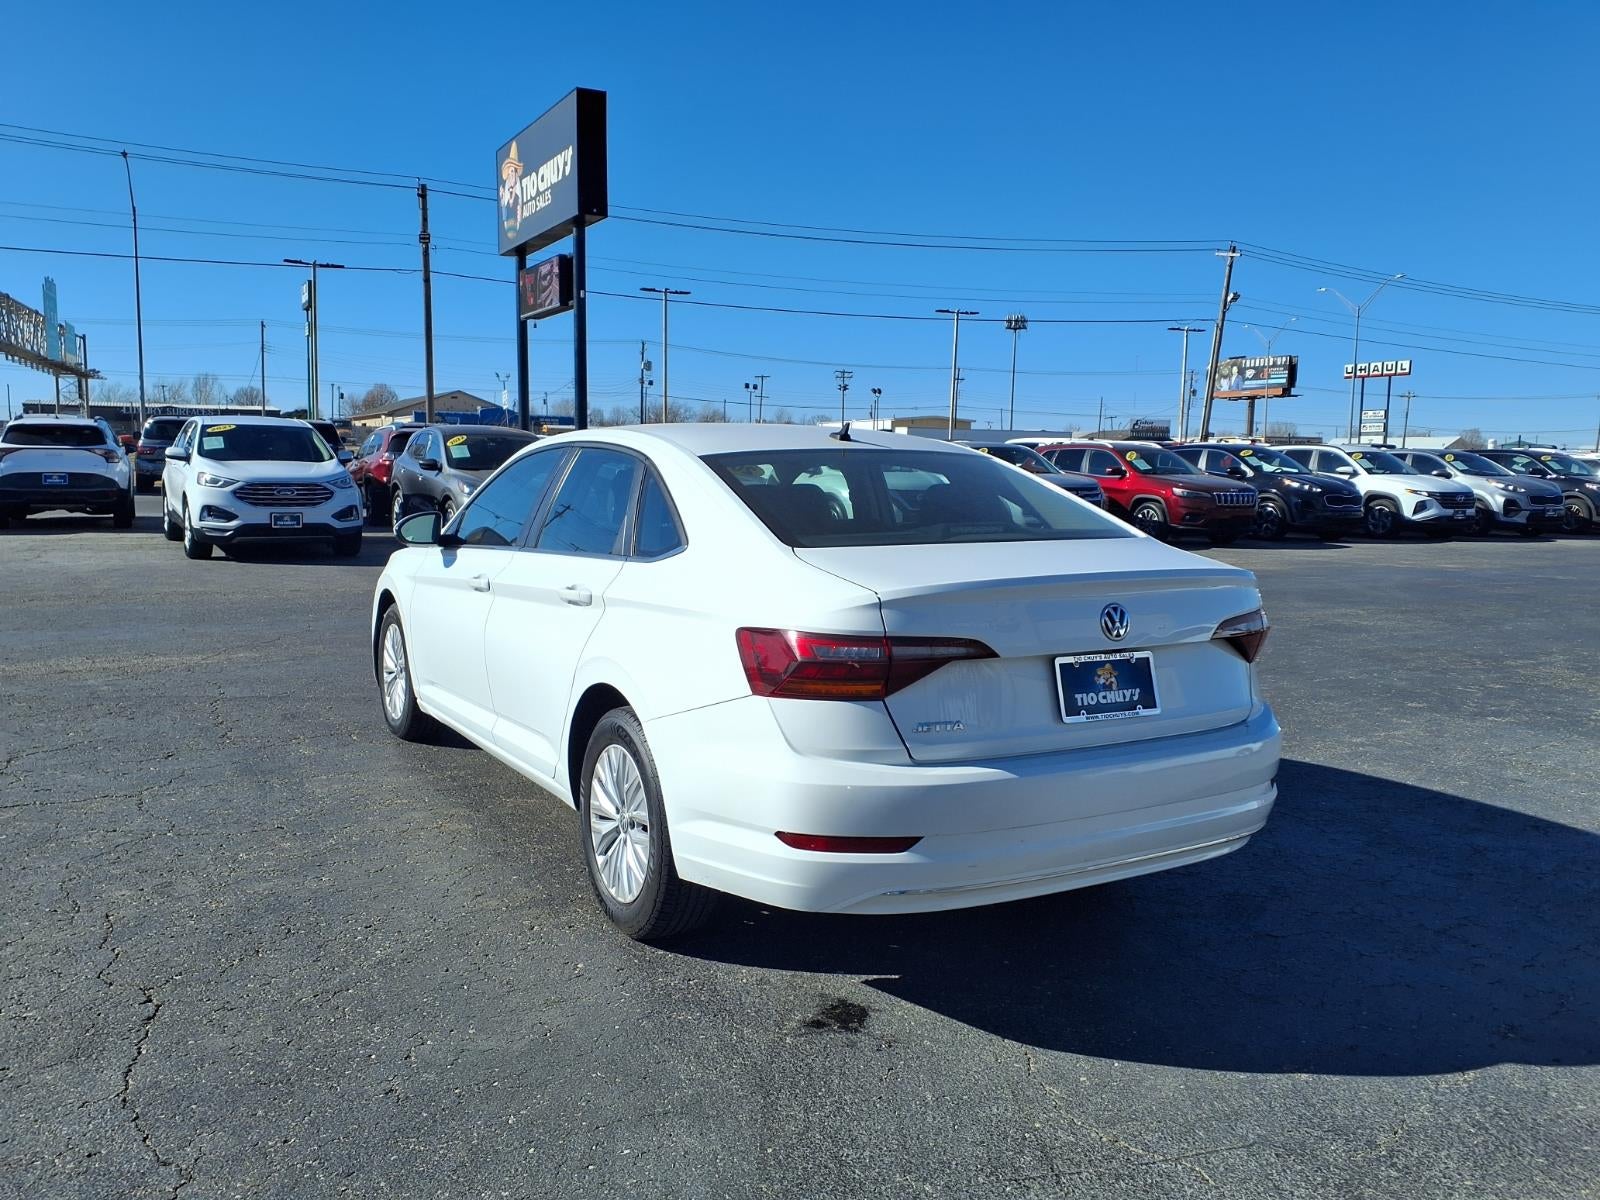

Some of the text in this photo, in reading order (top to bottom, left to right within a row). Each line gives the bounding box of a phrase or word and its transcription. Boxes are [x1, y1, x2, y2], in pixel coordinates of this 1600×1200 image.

[521, 145, 573, 203] TIO CHUY'S
[523, 189, 552, 219] AUTO SALES
[1075, 688, 1140, 706] TIO CHUY'S
